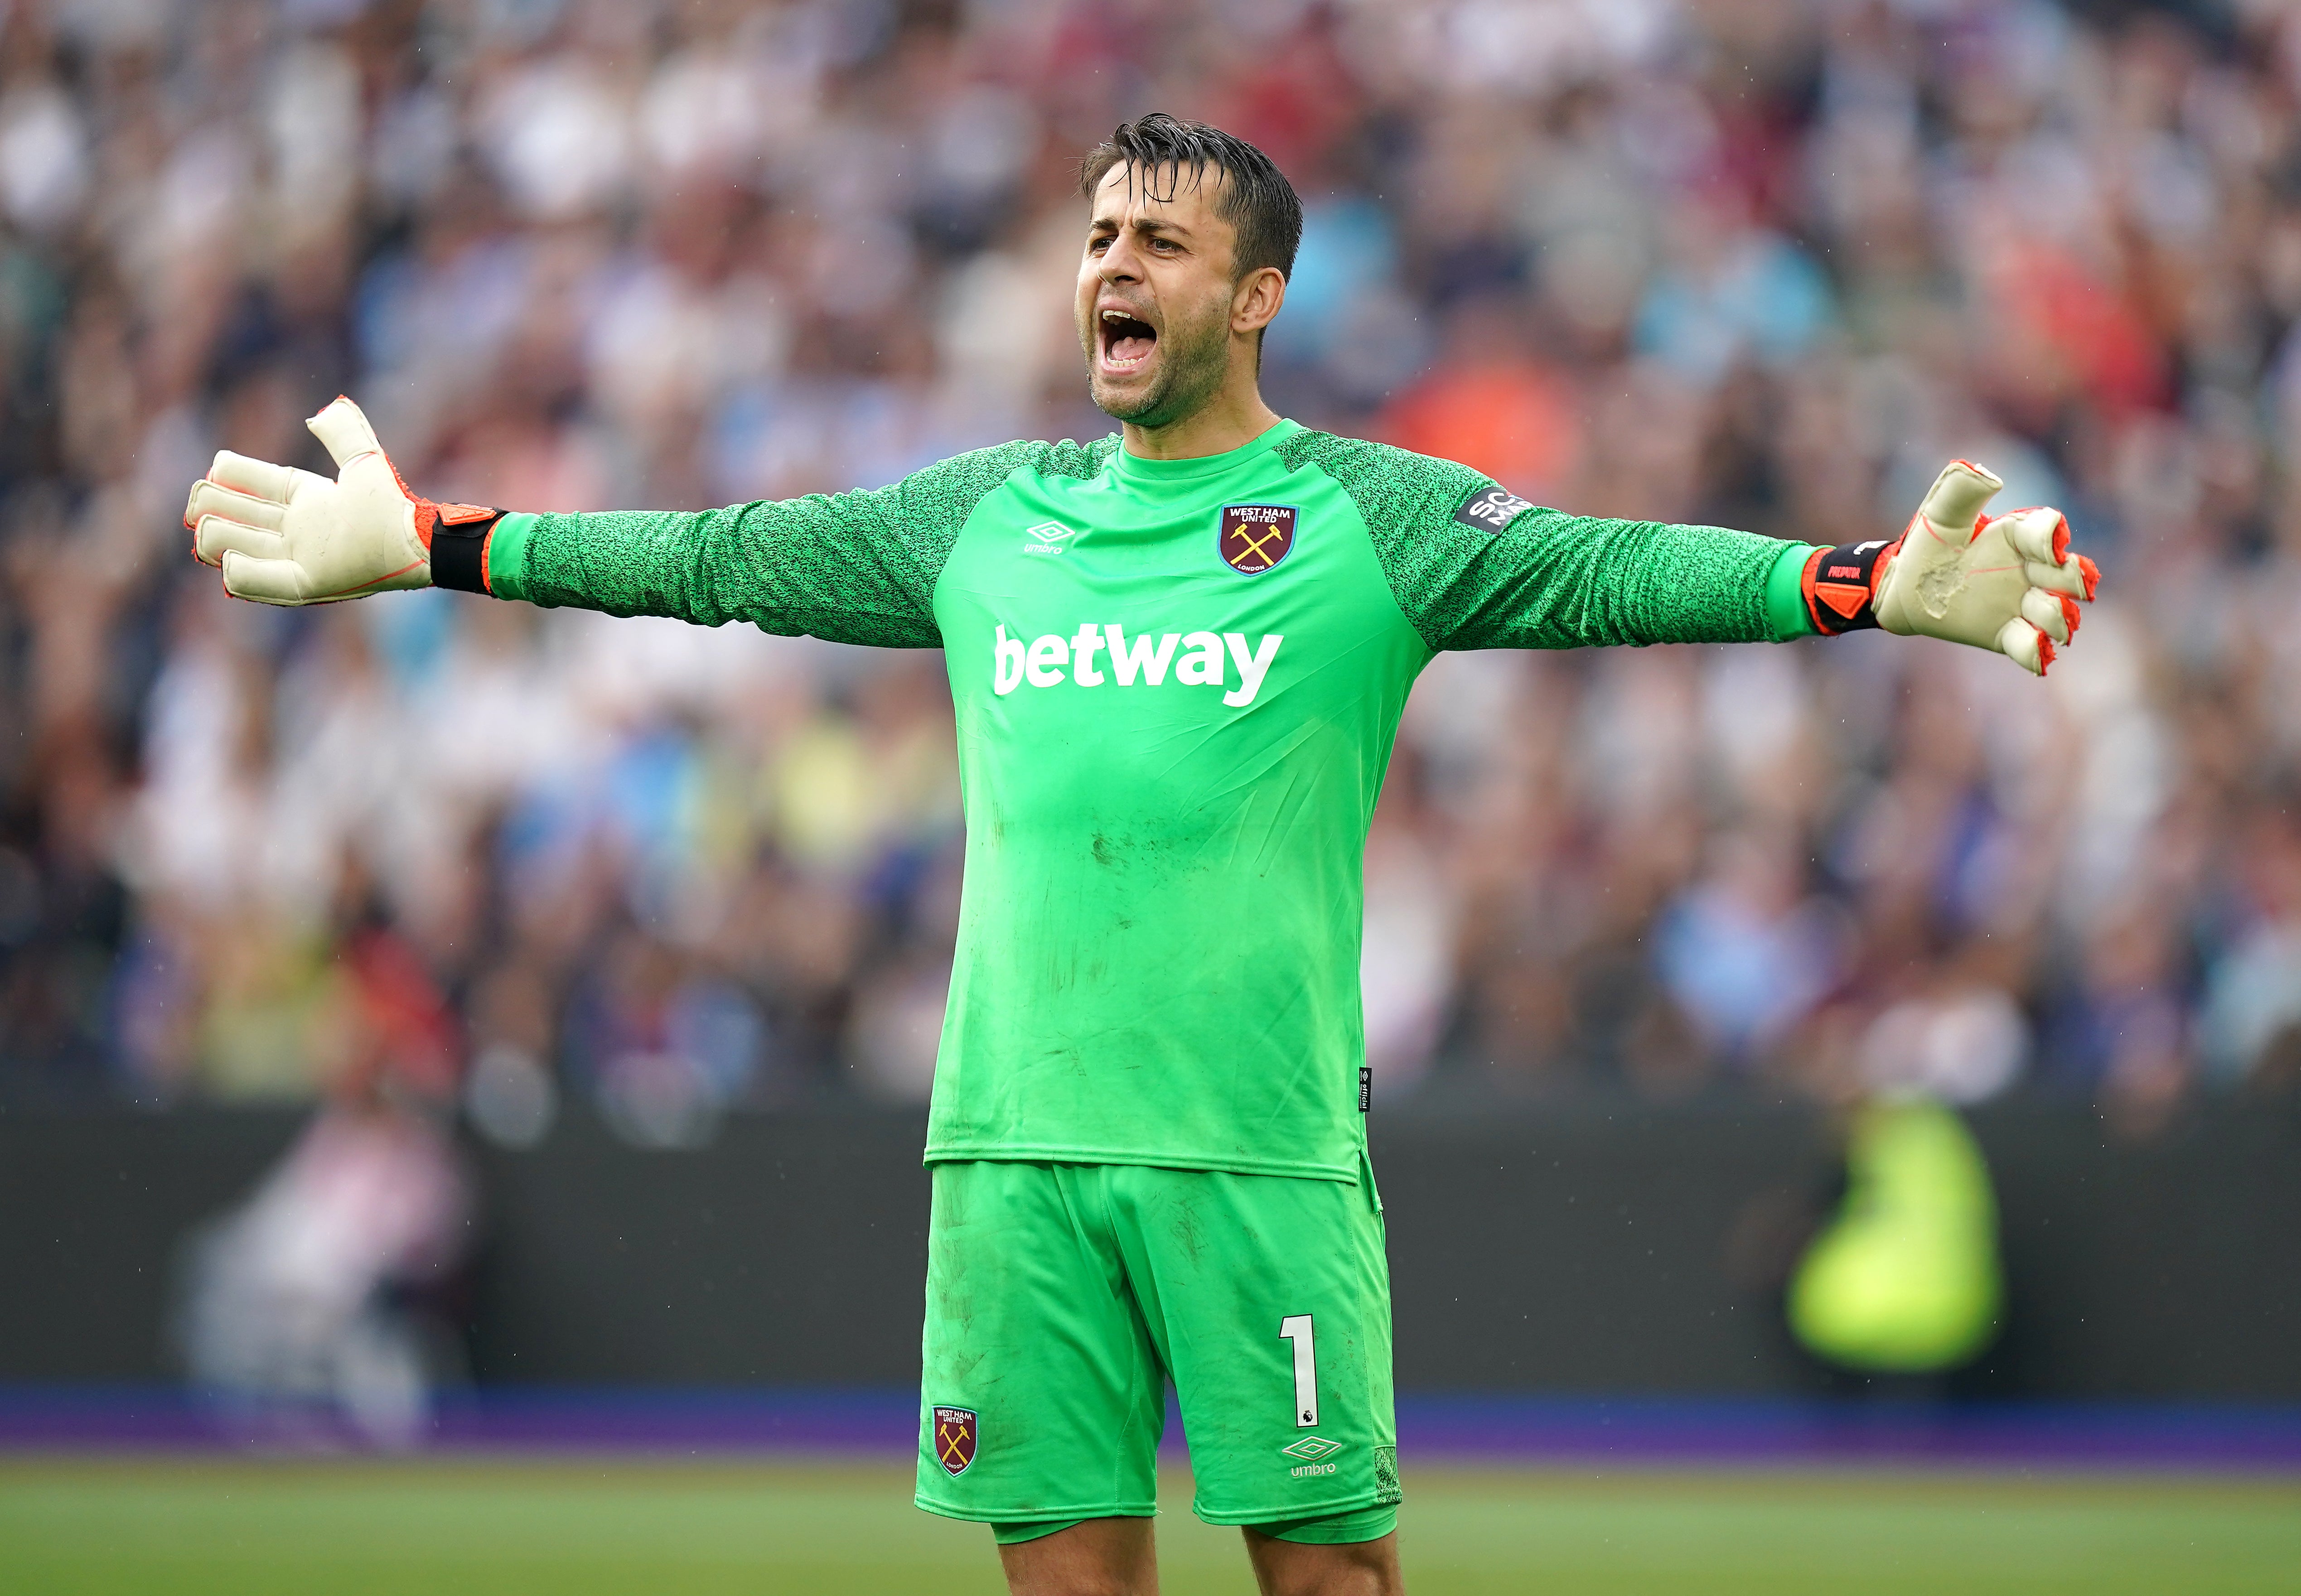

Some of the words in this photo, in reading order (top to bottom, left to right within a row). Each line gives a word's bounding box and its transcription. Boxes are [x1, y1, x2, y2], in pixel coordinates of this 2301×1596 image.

[1230, 507, 1261, 516] WEST
[1262, 508, 1290, 519] HAM
[1024, 543, 1062, 555] umbro
[995, 623, 1284, 707] betway
[1278, 1314, 1319, 1427] 1
[954, 1411, 972, 1420] HAM
[1291, 1463, 1336, 1476] umbro
